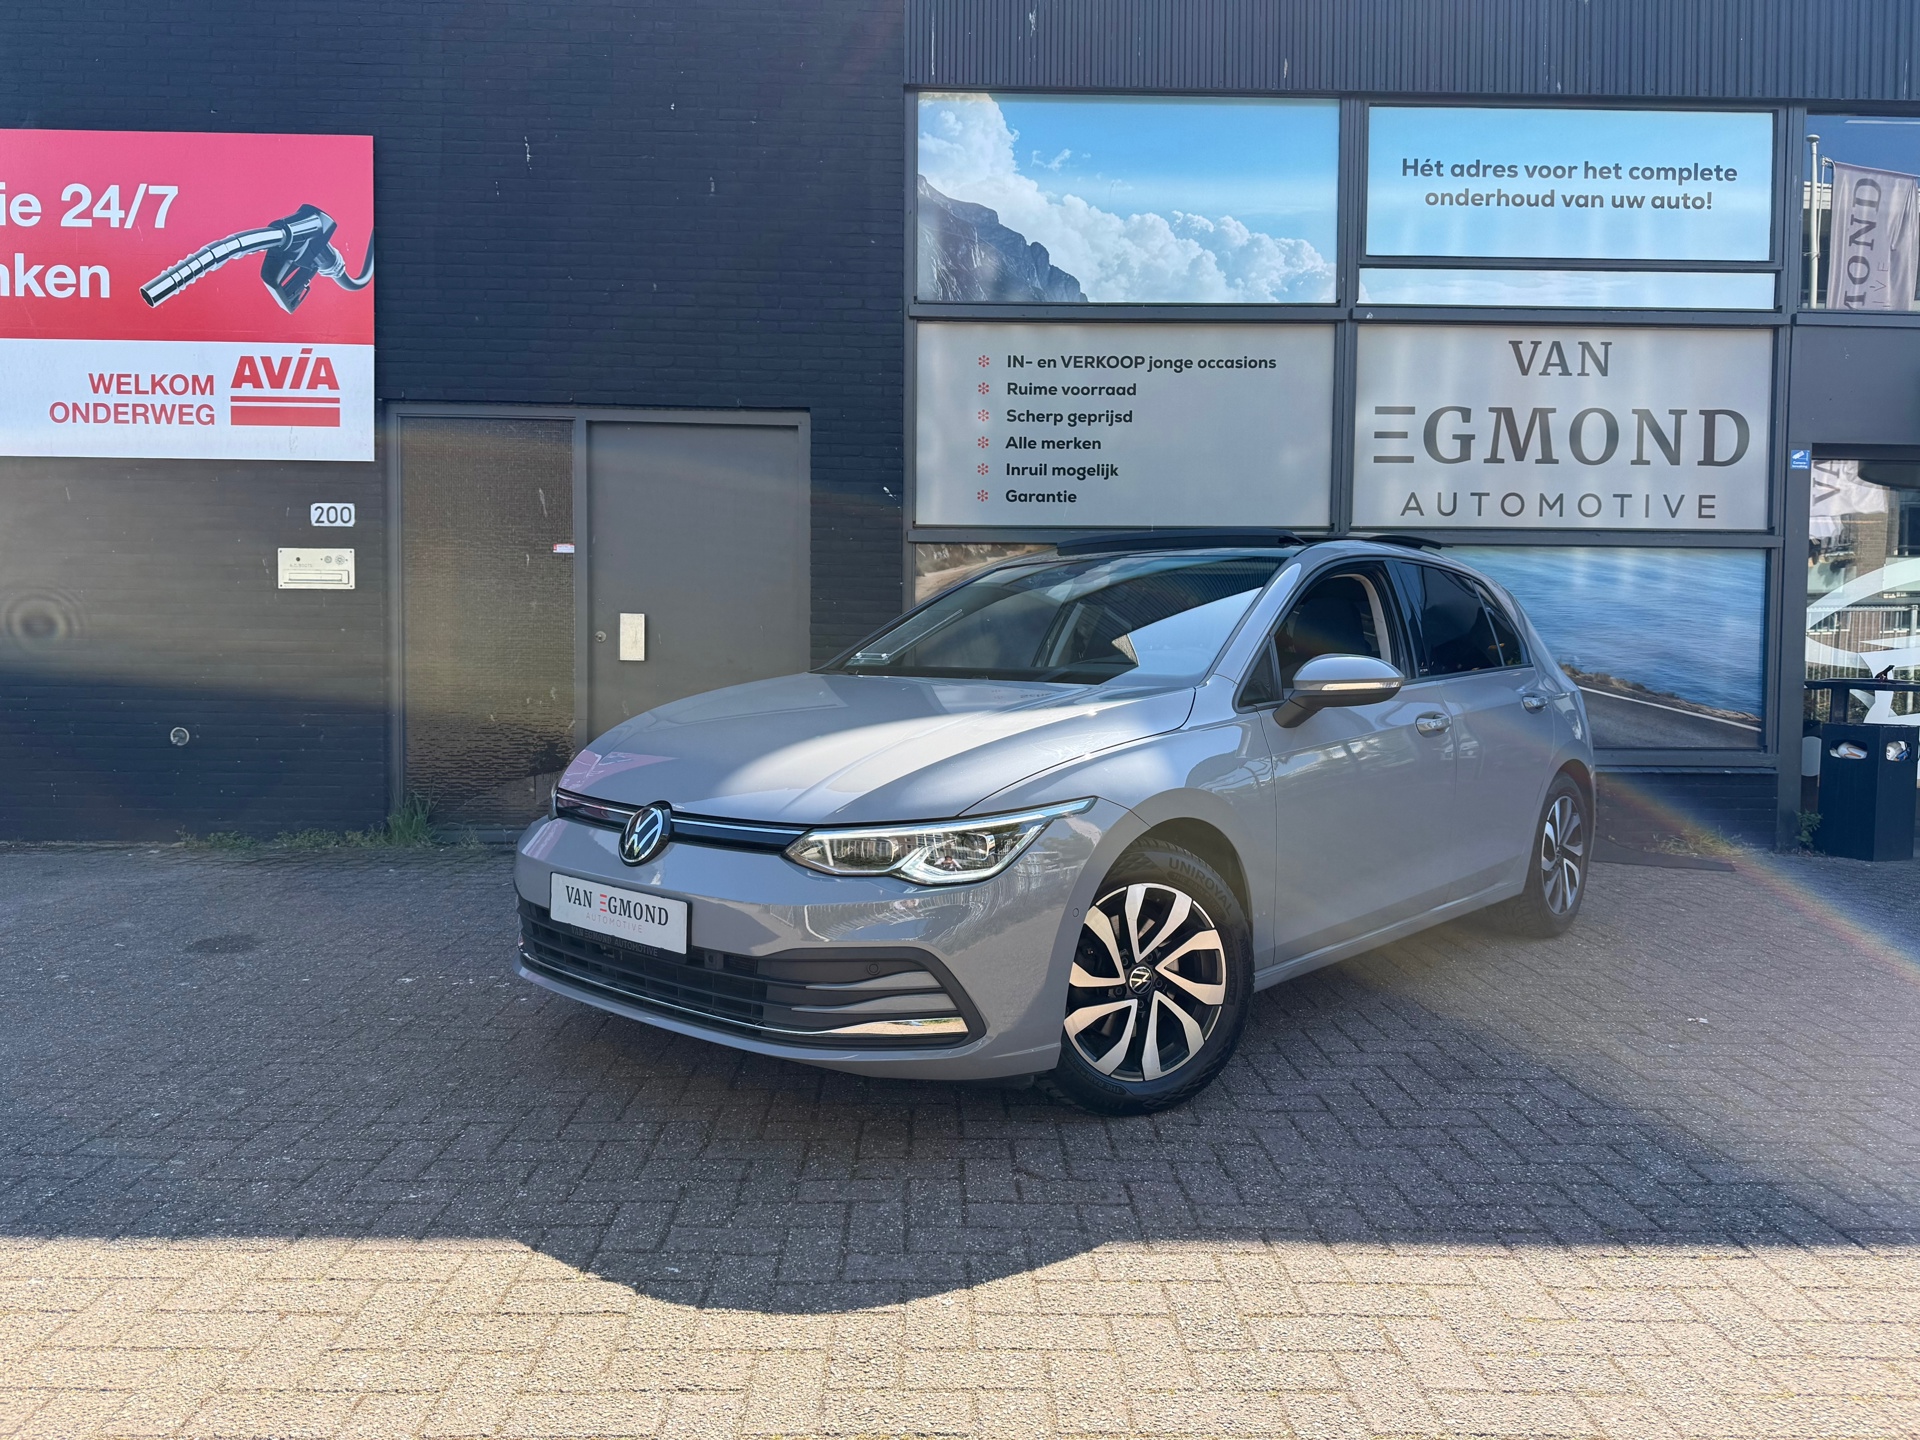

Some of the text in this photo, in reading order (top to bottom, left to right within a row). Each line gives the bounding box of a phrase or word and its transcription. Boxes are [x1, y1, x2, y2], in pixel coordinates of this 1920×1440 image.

[1401, 158, 1738, 186] Hét adres voor het complete
[60, 183, 179, 229] 24/7
[1425, 188, 1713, 210] onderhoud van uw auto!
[1007, 355, 1277, 374] IN- en VERKOOP jonge occasions
[1508, 340, 1613, 377] VAN
[88, 372, 215, 396] WELKOM
[1007, 382, 1137, 396] Ruime voorraad
[49, 401, 216, 426] ONDERWEG
[1006, 409, 1133, 427] Scherp geprijsd
[1005, 436, 1101, 450] Alle merken
[1373, 405, 1750, 467] EGMOND
[1005, 463, 1119, 481] Inruil mogelijk
[1005, 489, 1077, 503] Garantie
[1400, 491, 1717, 519] AUTOMOTIVE
[314, 505, 352, 524] 200
[1168, 857, 1233, 916] UNIROYAL
[565, 885, 669, 926] VAN EGMOND
[586, 912, 643, 934] AUTOMOTIVE
[614, 939, 659, 957] AUTOMOTIVE
